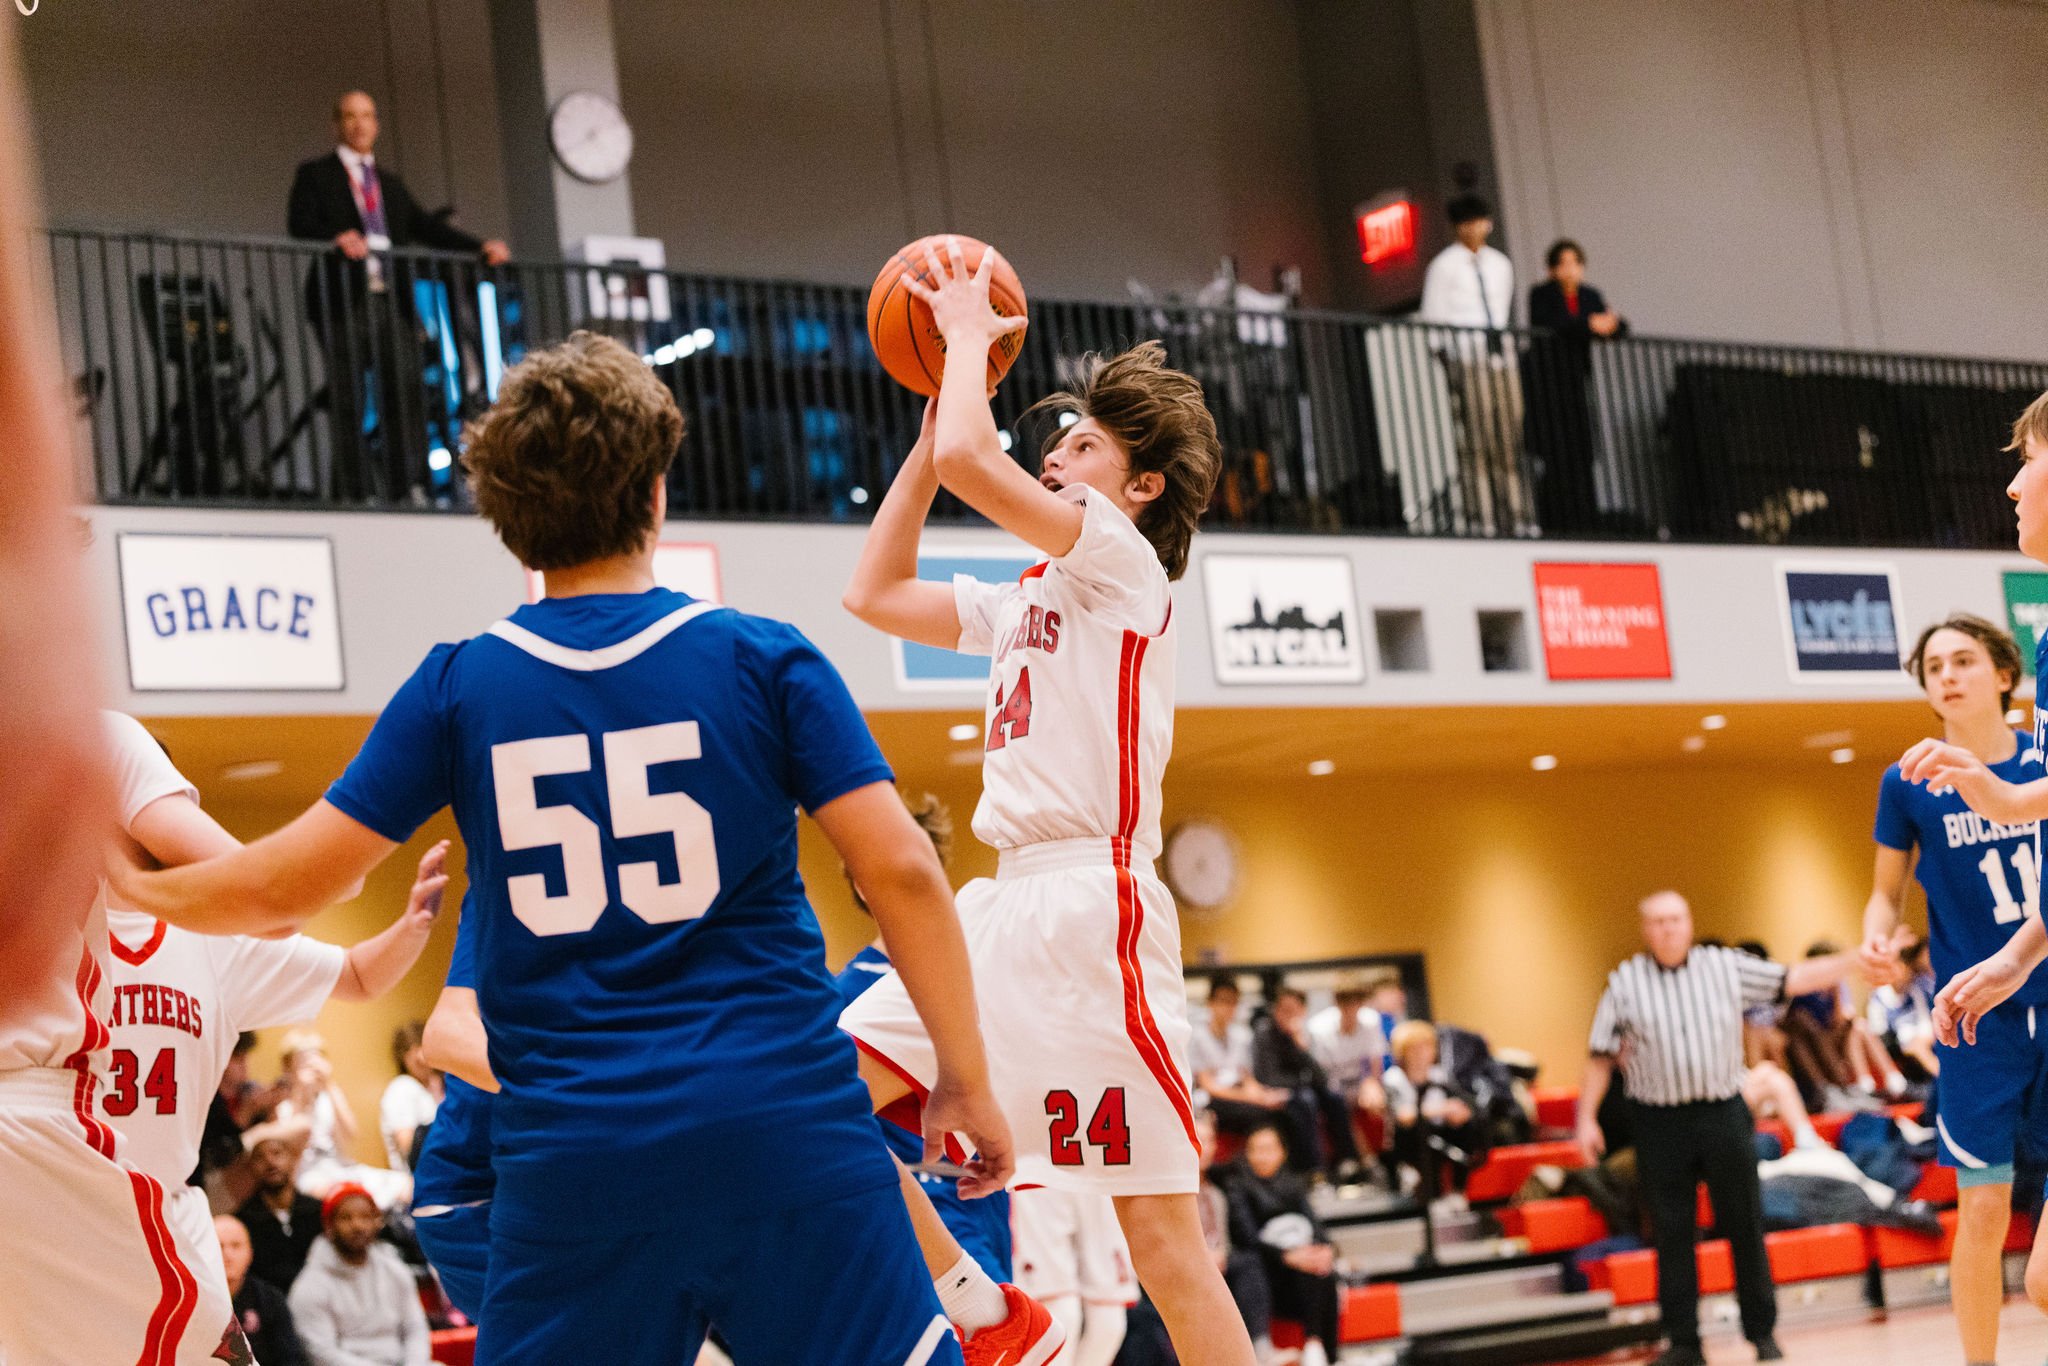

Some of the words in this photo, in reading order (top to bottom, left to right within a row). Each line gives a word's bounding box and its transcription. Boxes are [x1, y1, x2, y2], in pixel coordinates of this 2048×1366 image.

[147, 586, 313, 638] GRACE
[491, 720, 721, 937] 55
[1979, 842, 2040, 925] 11
[108, 984, 203, 1039] NTHERS
[102, 1048, 178, 1117] 34
[1044, 1087, 1131, 1166] 24
